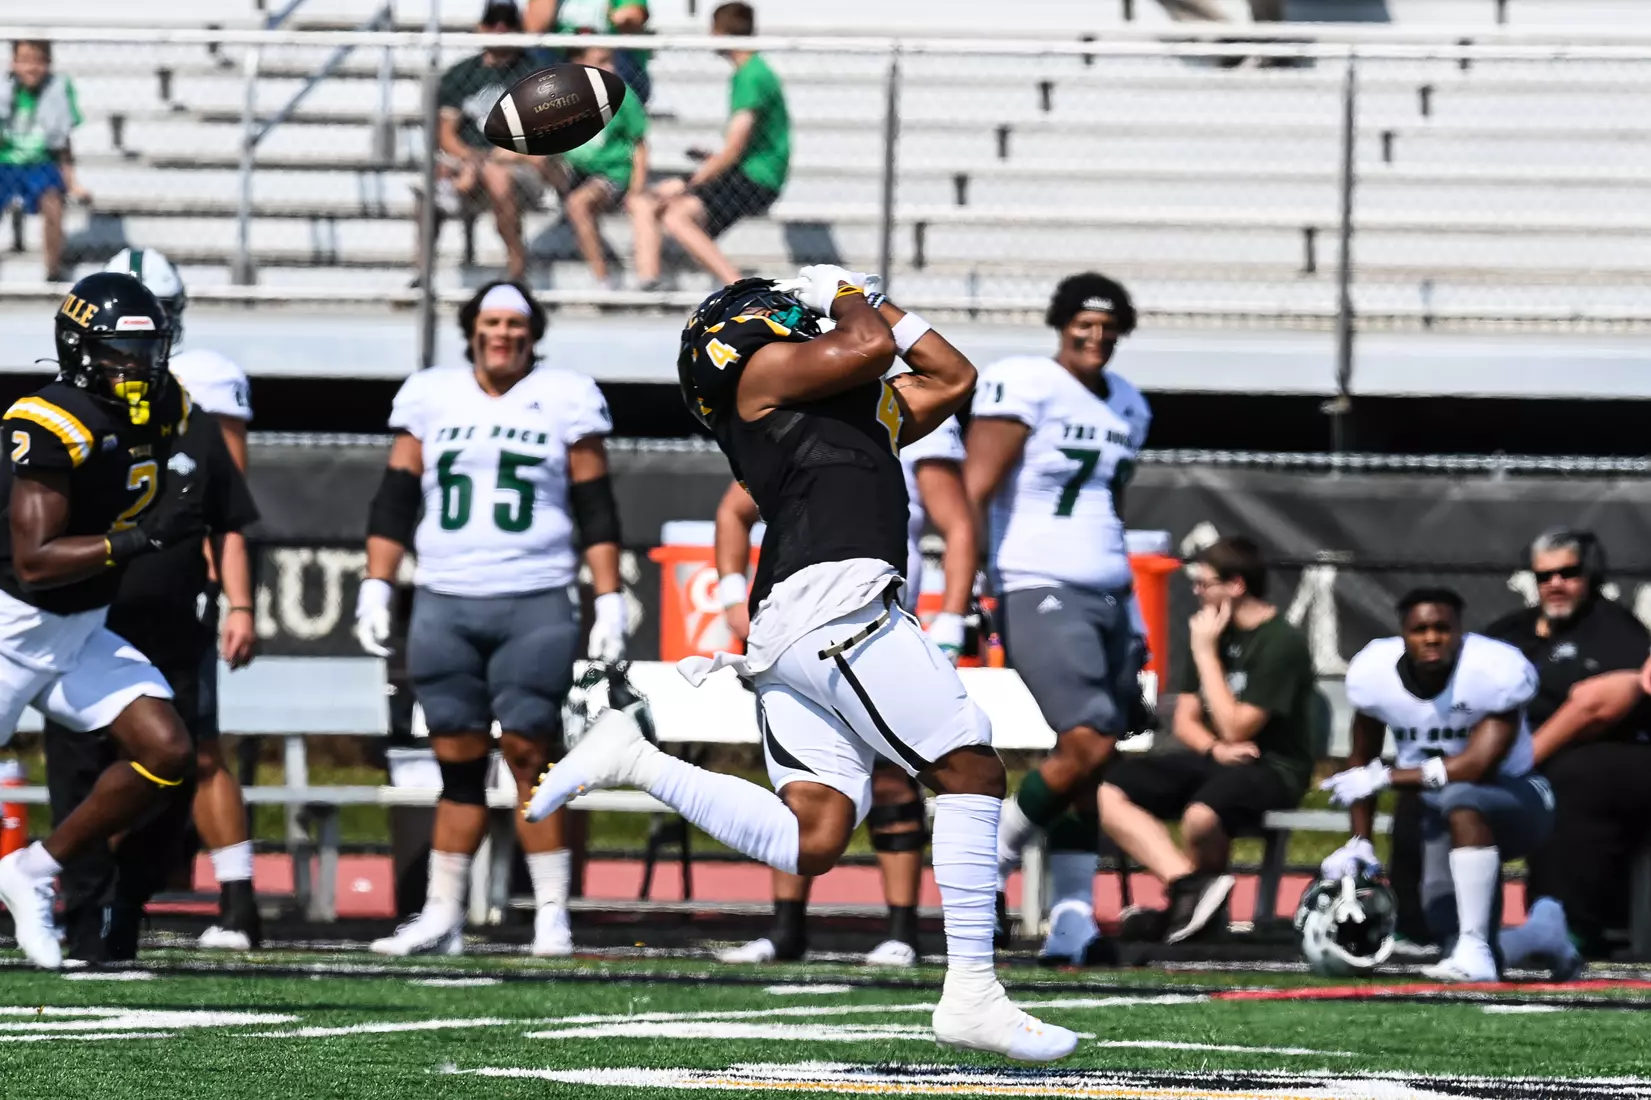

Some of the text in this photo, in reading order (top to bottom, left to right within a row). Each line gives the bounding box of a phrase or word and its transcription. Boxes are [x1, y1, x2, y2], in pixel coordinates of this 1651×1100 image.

[533, 92, 579, 114] Wilson
[61, 293, 99, 328] ILLE
[705, 337, 741, 370] 4
[11, 430, 30, 464] 2
[108, 460, 158, 533] 2
[437, 448, 547, 533] 65
